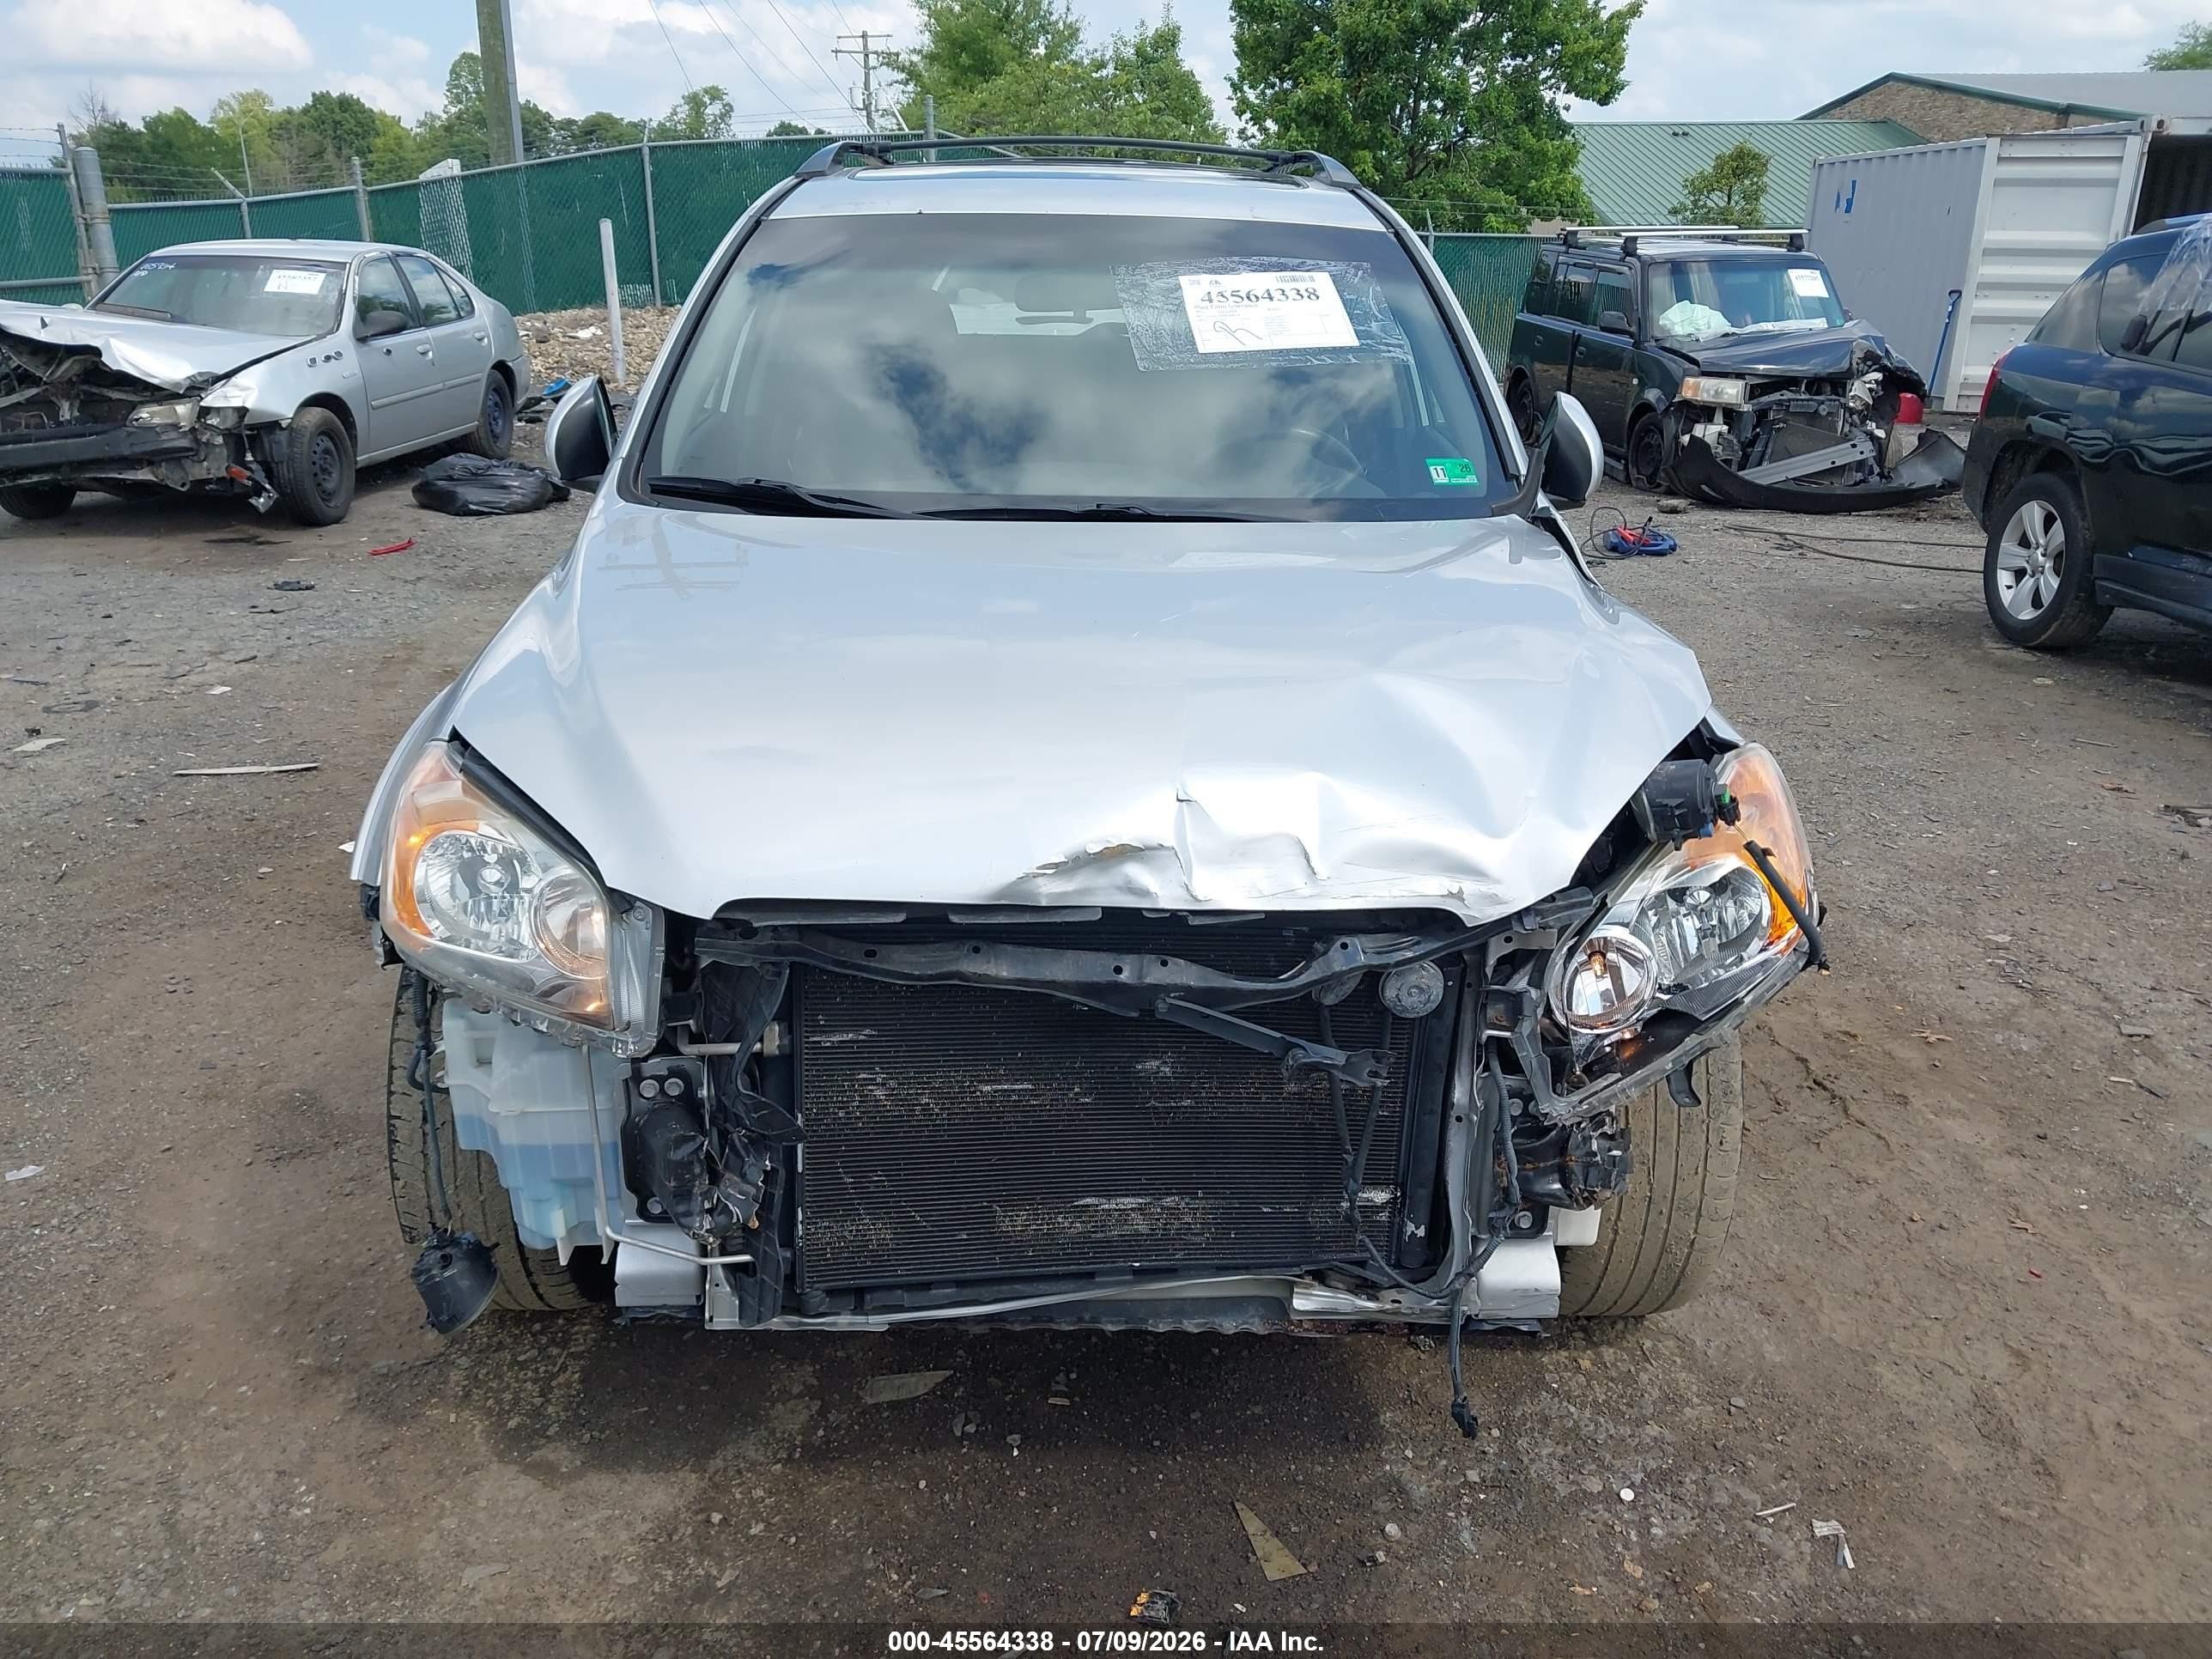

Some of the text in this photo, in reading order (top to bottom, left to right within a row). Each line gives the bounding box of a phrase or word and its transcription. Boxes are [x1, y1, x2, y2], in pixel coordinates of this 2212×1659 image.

[1200, 288, 1320, 303] 45564338
[1432, 464, 1472, 477] 11 26
